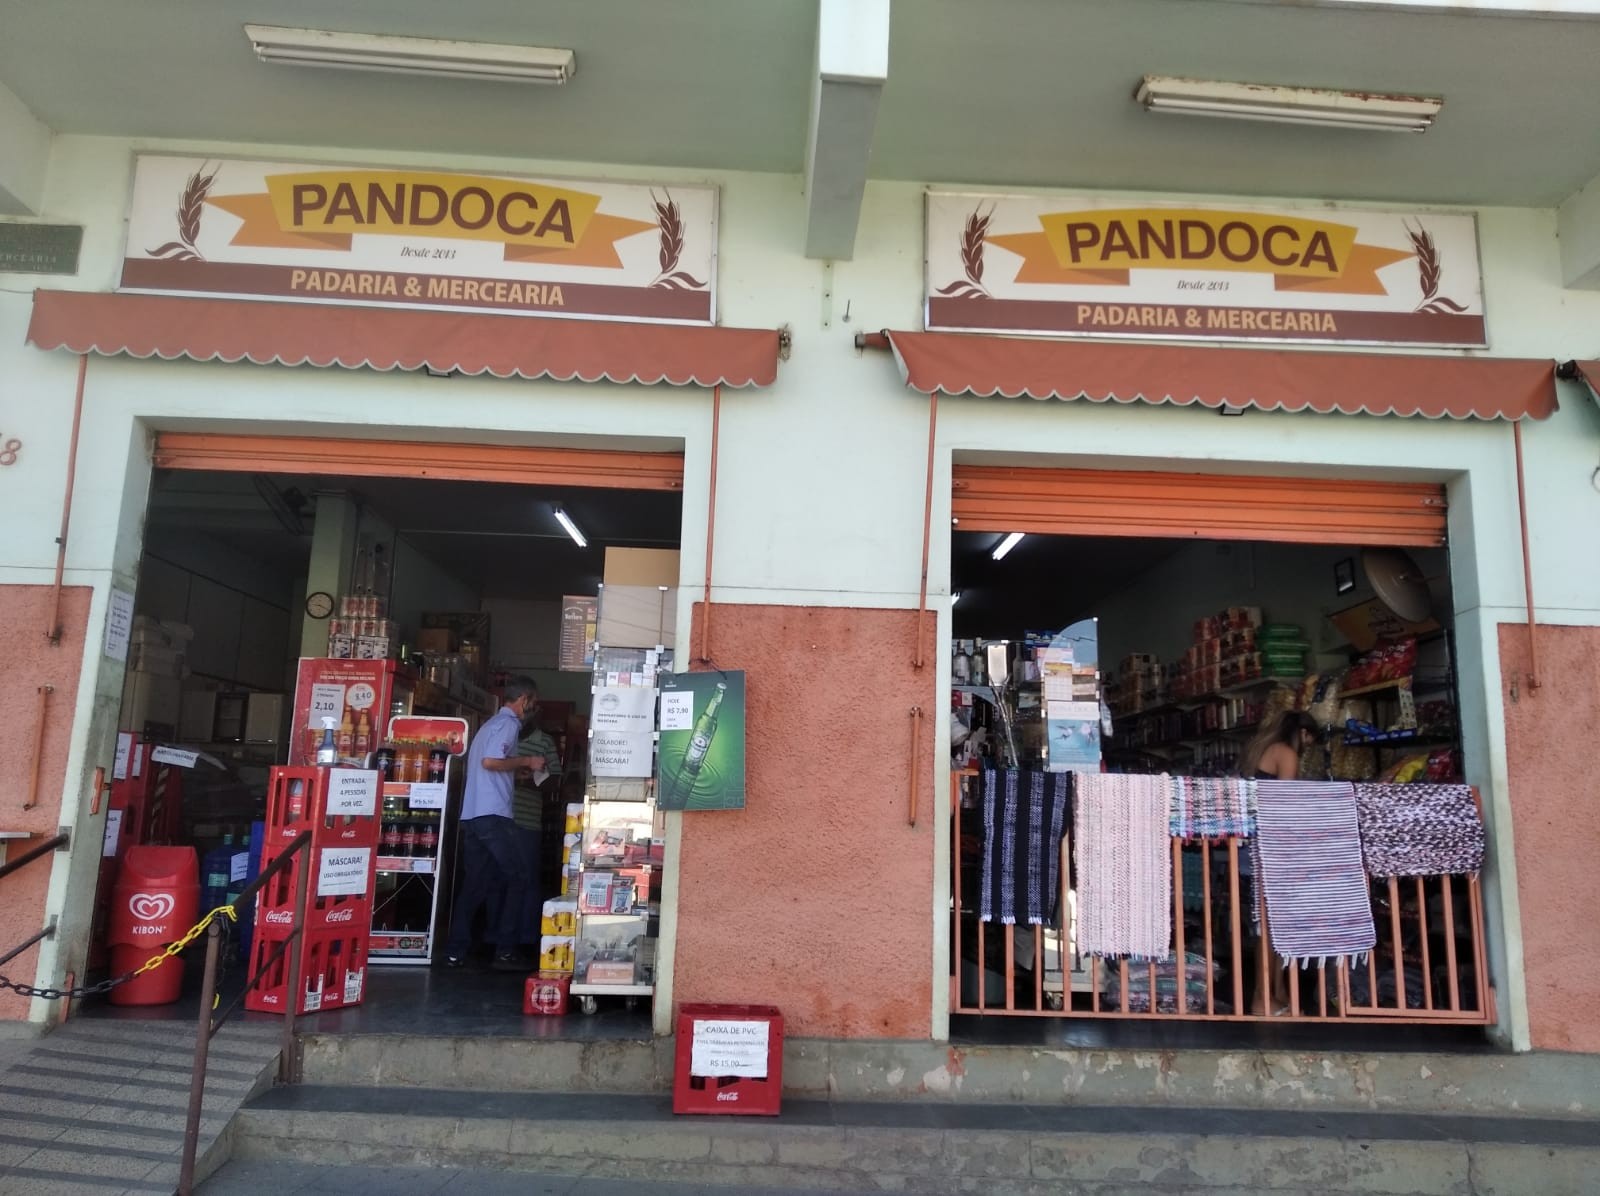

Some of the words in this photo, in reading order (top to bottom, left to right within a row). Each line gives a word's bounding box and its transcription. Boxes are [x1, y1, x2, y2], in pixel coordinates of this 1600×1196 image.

[292, 182, 575, 243] PANDOCA
[1066, 218, 1339, 272] PANDOCA
[400, 246, 430, 259] Desde
[432, 248, 457, 260] 2013
[290, 269, 397, 297] PADARIA
[405, 276, 422, 297] &
[427, 278, 565, 306] MERCEARIA
[1177, 279, 1205, 291] Desde
[1207, 280, 1230, 291] 2013
[1077, 305, 1179, 327] PADARIA
[1185, 308, 1202, 328] &
[1207, 309, 1337, 333] MERCEARIA
[314, 702, 334, 711] 2,10
[328, 856, 363, 867] MÁSCARA!
[132, 926, 163, 935] KIBON
[705, 1026, 729, 1034] CAIXA
[730, 1026, 740, 1034] DE
[742, 1027, 757, 1035] PVC
[709, 1059, 720, 1068] R$
